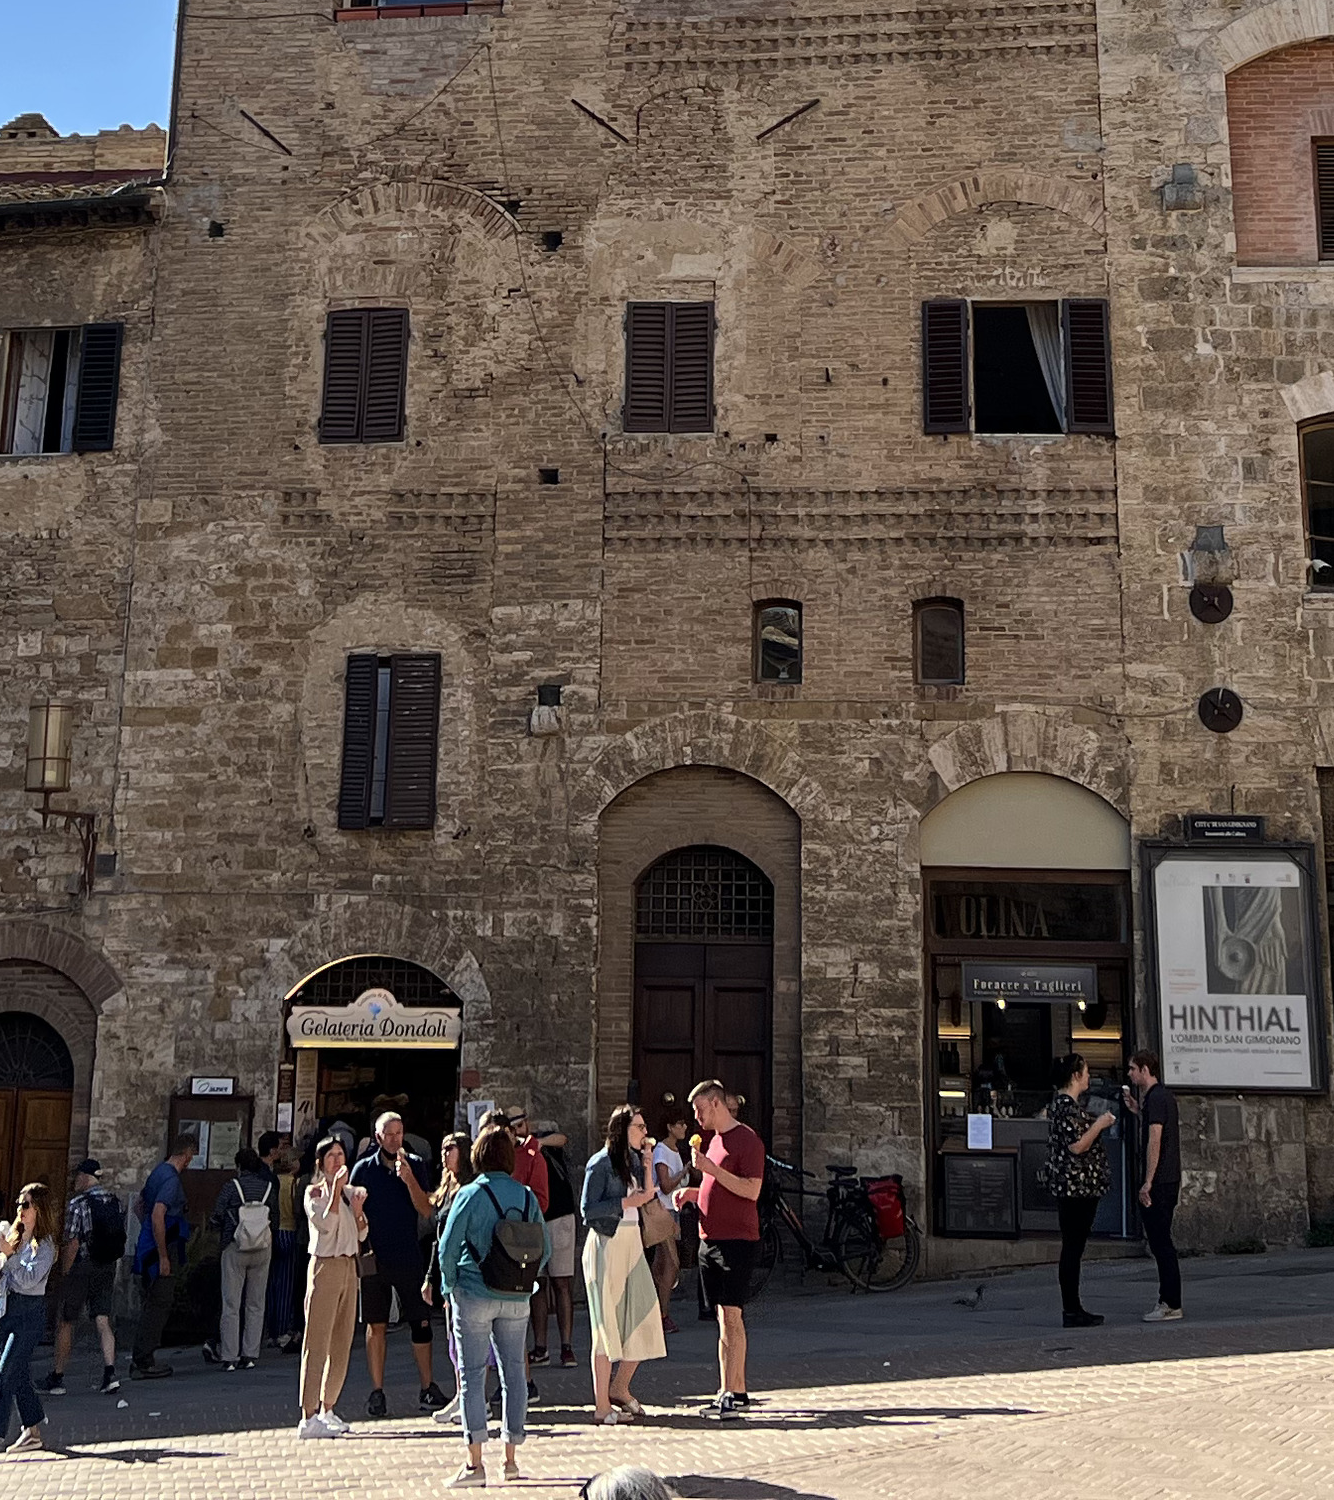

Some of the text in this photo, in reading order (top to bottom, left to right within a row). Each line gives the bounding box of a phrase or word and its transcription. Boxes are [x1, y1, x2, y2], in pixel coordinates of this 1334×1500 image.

[1033, 980, 1082, 993] Taglieri
[300, 1016, 448, 1038] Gelateria Dondoli
[1169, 1004, 1300, 1033] HINTHIAL
[1170, 1034, 1302, 1046] L'OMBRA DI SAN GIMIGNANO
